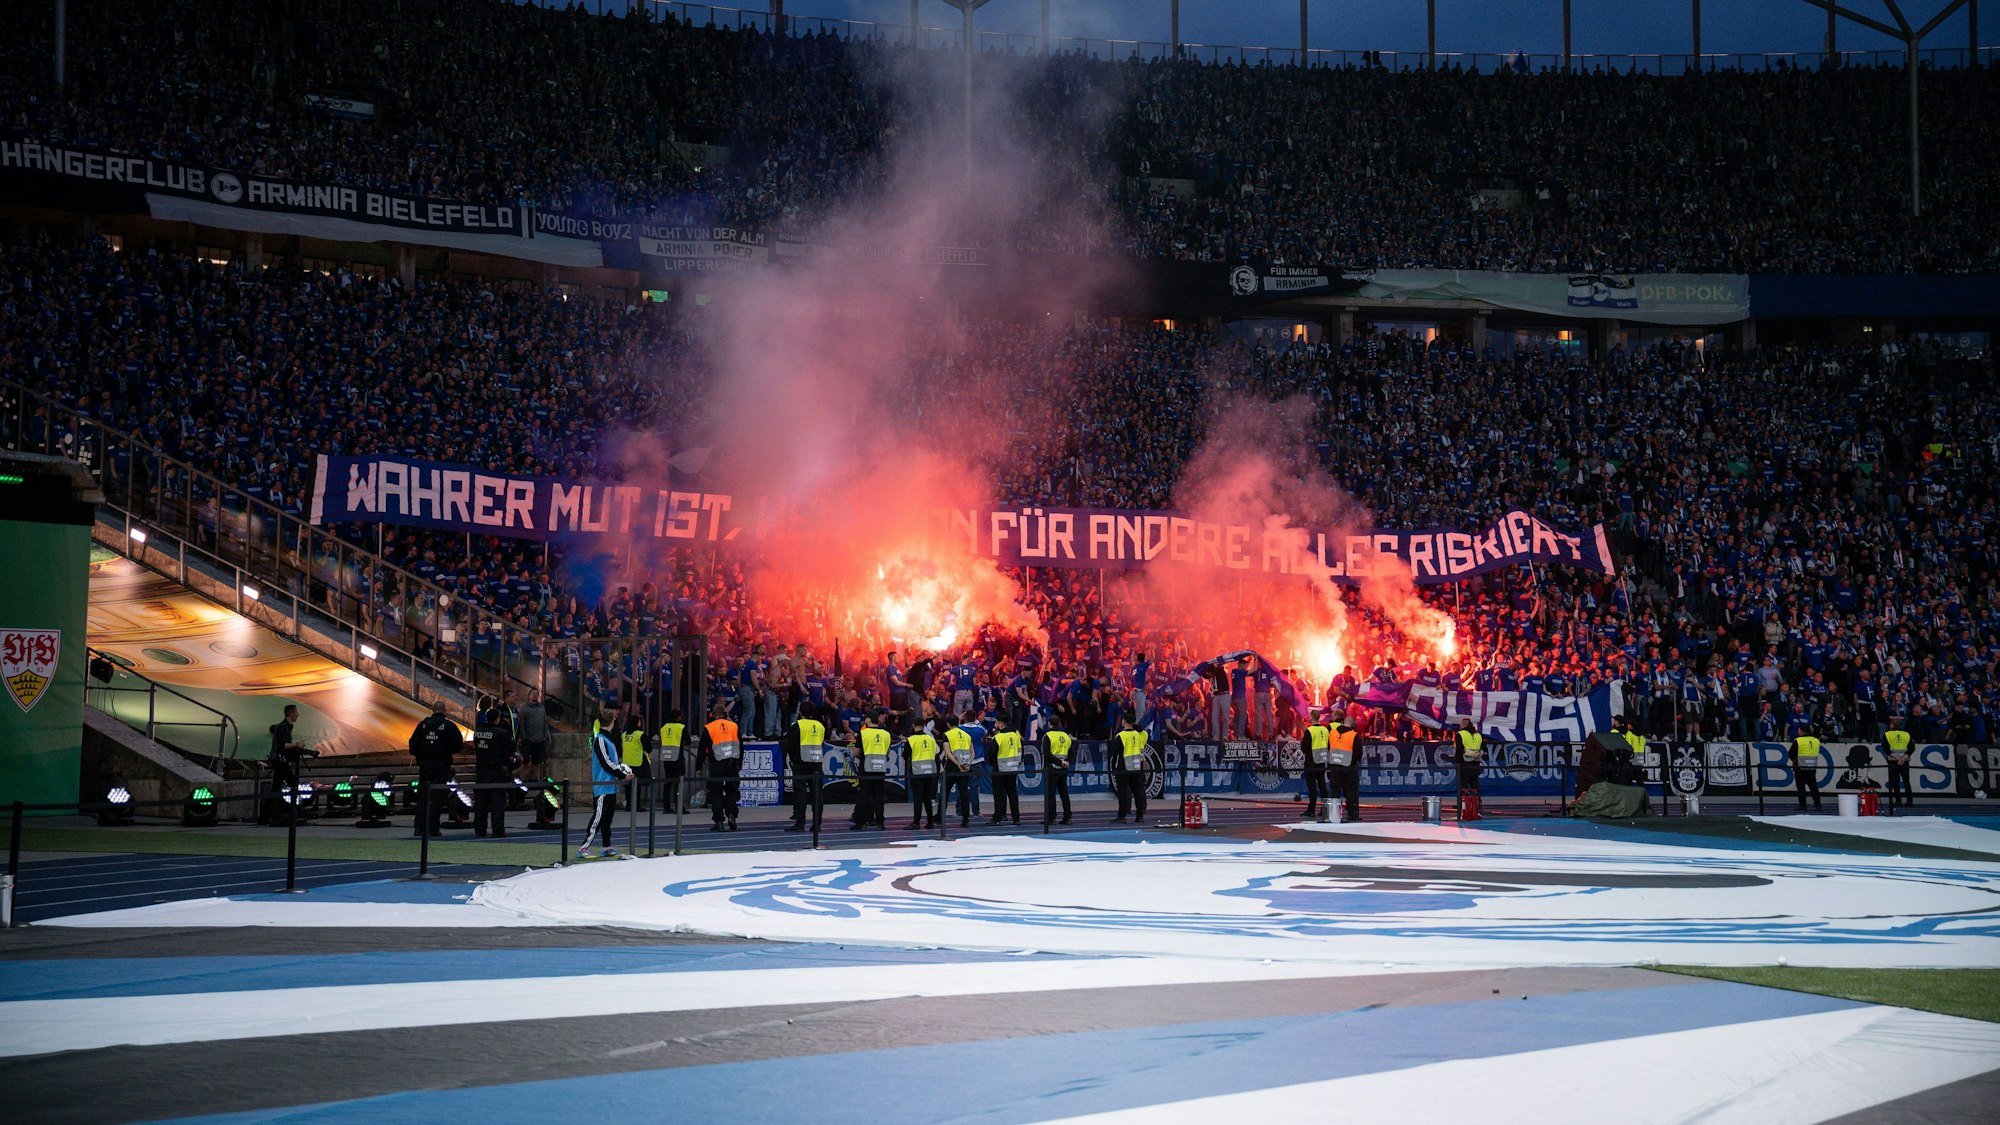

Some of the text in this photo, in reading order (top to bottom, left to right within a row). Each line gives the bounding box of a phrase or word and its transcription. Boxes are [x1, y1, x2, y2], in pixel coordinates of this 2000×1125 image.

[0, 138, 513, 229] HÄNGERCLUB ARMINIA BIELEFELD
[592, 219, 632, 240] BOYZ
[642, 225, 764, 244] MACHT VON DER ALM
[656, 243, 704, 255] ARMINIA
[1270, 266, 1318, 276] FÜR IMMER
[1277, 279, 1316, 289] ARMINIA
[347, 460, 535, 528] WAHRER
[549, 482, 641, 532] MUT
[990, 506, 1075, 558] FÜR
[1091, 513, 1250, 570] ANDERE
[1263, 525, 1398, 577] ALLES
[1410, 512, 1583, 577] RISKIERT
[3, 633, 56, 666] VfB
[475, 731, 493, 739] POLIZEI
[1164, 744, 1234, 787] REW
[1359, 744, 1456, 786] TRAS
[1538, 745, 1565, 780] 05
